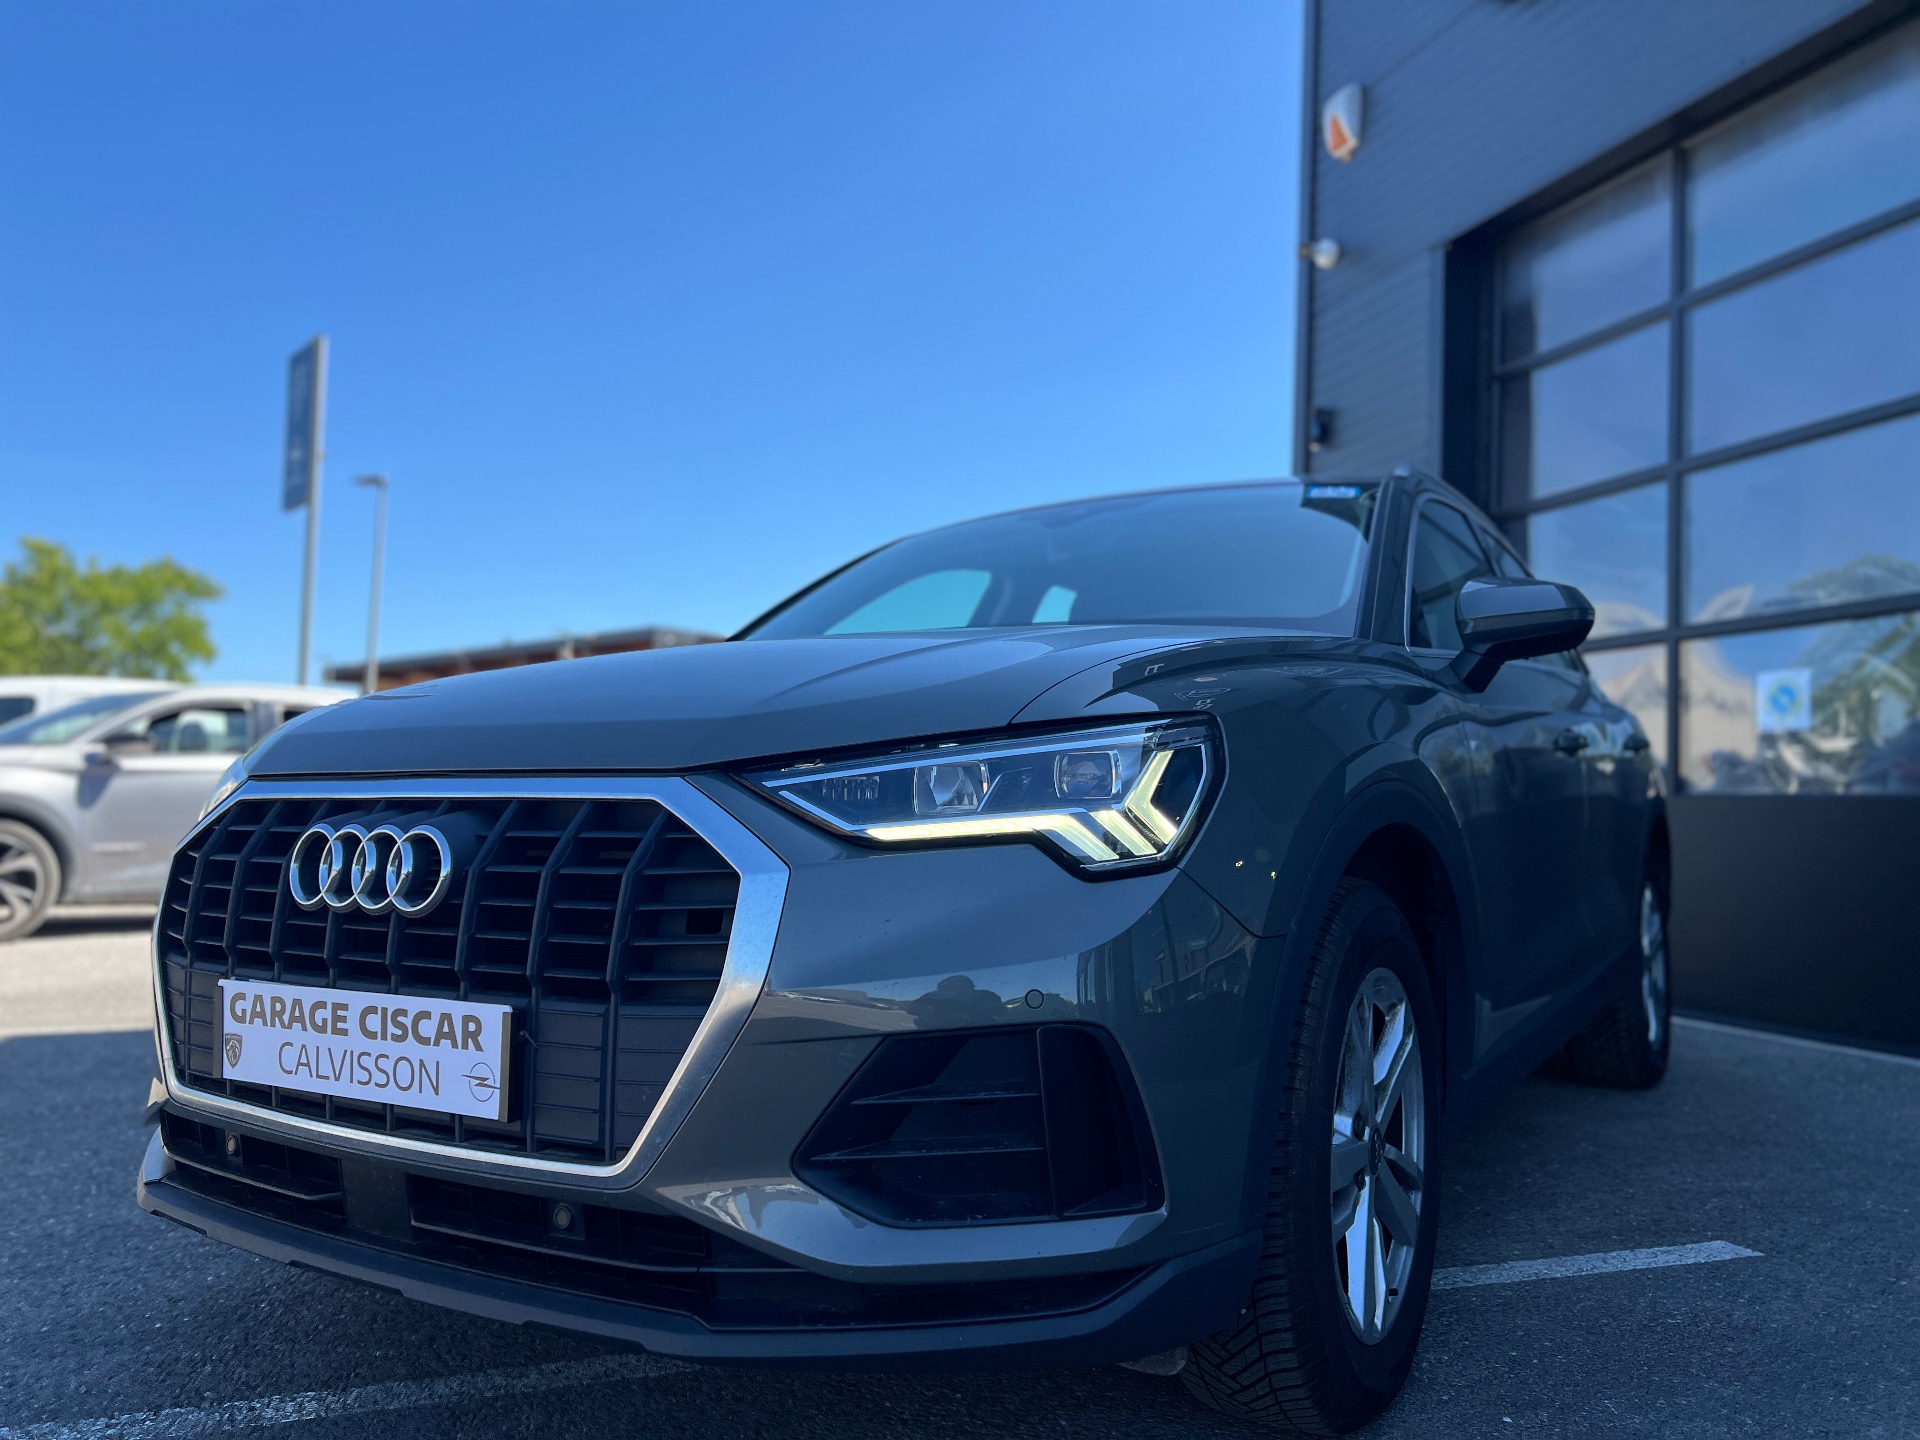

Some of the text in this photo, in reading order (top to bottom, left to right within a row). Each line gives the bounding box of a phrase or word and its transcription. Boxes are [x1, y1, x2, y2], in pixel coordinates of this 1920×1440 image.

[229, 992, 484, 1052] GARAGE CISCAR
[278, 1042, 440, 1096] CALVISSON
